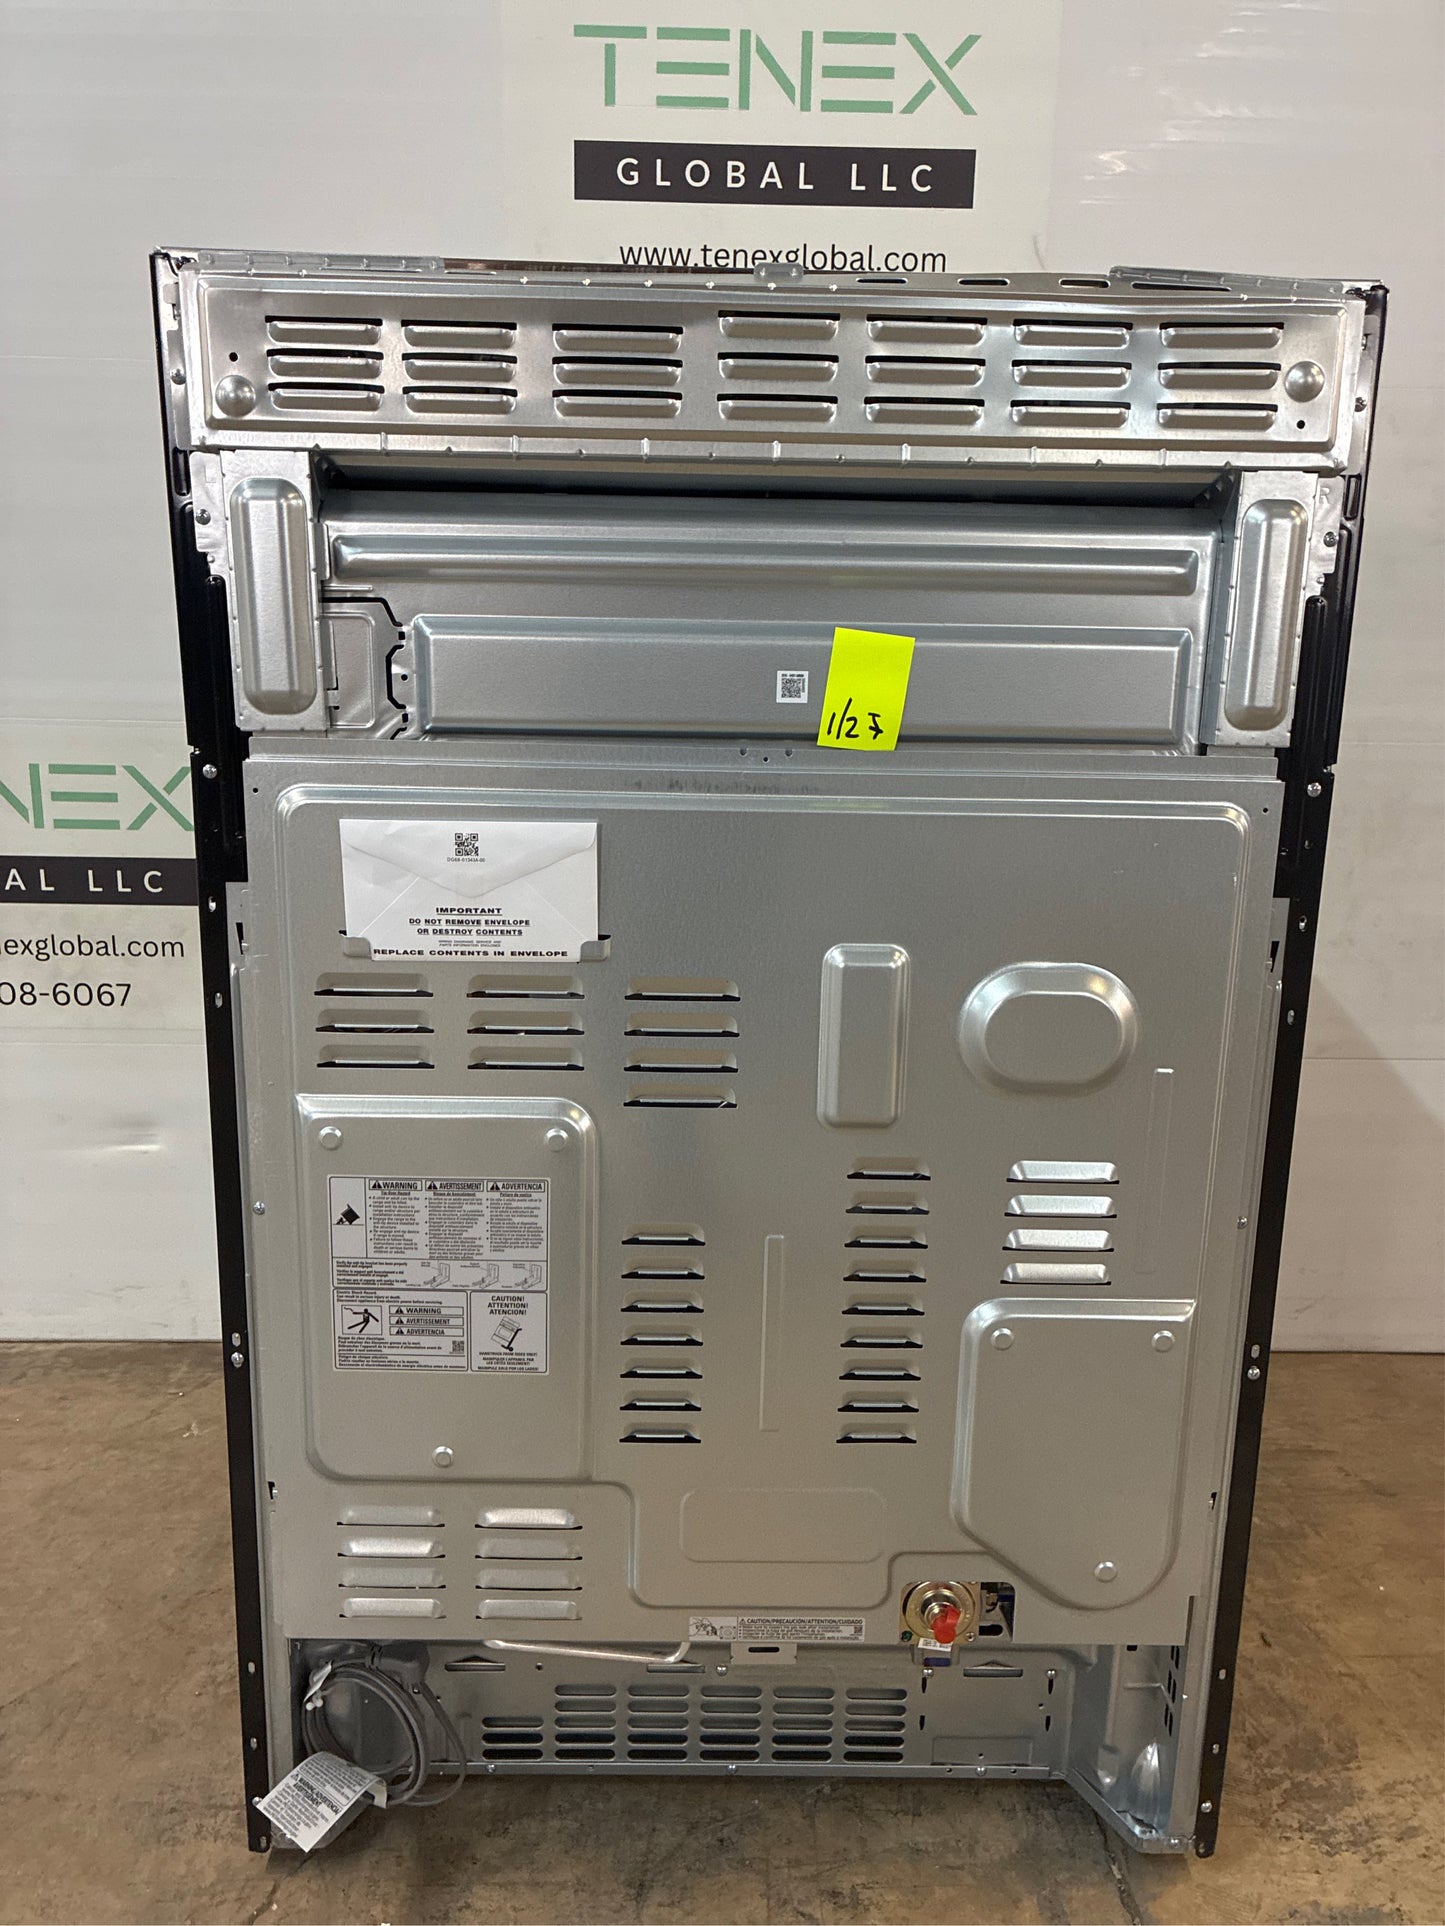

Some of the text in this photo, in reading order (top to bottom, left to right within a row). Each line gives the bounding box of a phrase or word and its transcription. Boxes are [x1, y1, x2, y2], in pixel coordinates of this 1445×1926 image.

[573, 24, 982, 115] TENEX
[616, 158, 932, 193] GLOBAL LLC
[4, 868, 163, 893] AL LLC
[436, 907, 502, 915] IMPORTANT
[445, 918, 482, 926] REMOVE
[432, 928, 473, 936] DESTROY
[0, 934, 184, 961] exglobal.com
[373, 948, 424, 956] REPLACE
[429, 949, 489, 957] CONTENTS
[0, 982, 131, 1007] 08-6067
[382, 1182, 418, 1190] WARNING
